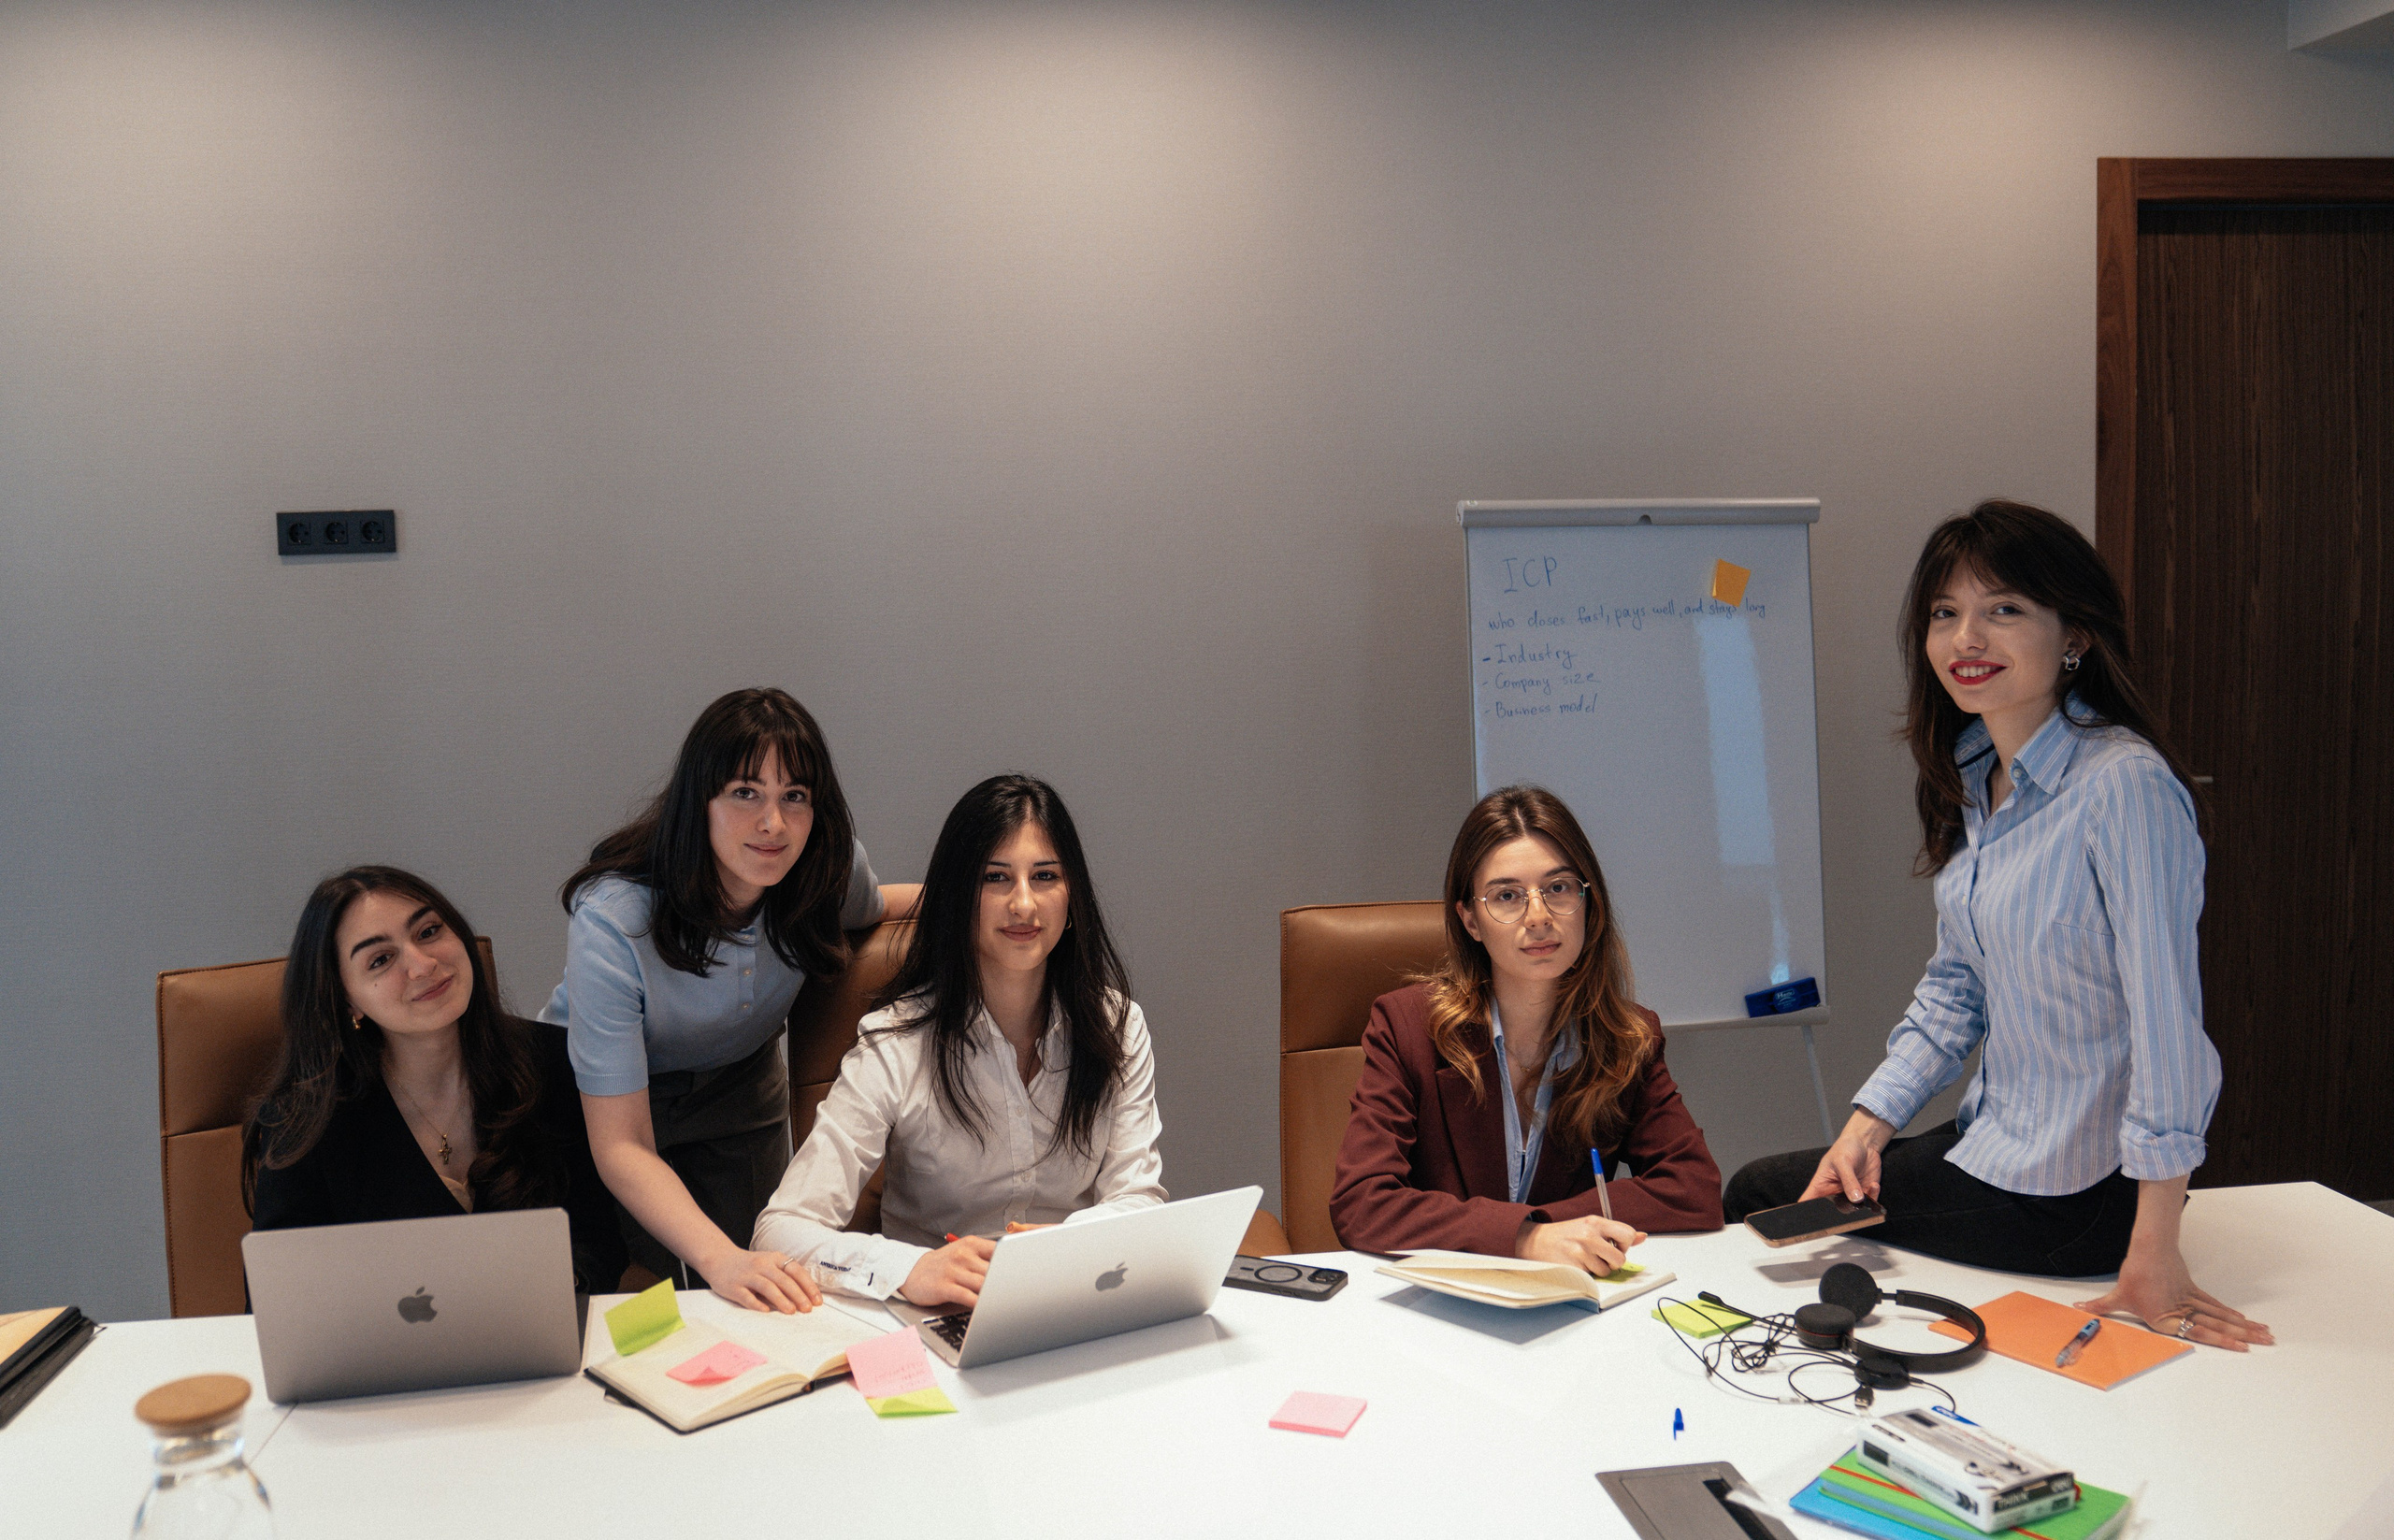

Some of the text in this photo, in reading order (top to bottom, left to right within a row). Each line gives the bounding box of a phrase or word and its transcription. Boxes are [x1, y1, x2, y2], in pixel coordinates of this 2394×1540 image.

[1502, 555, 1557, 594] ICP
[1488, 612, 1515, 630] who
[1615, 608, 1646, 630] pays
[1709, 599, 1738, 620] stays
[1746, 597, 1767, 617] long
[1494, 643, 1578, 669] Industry
[1494, 672, 1551, 695] Company
[1563, 673, 1601, 685] size
[1495, 701, 1551, 719] Business
[1559, 693, 1598, 714] model
